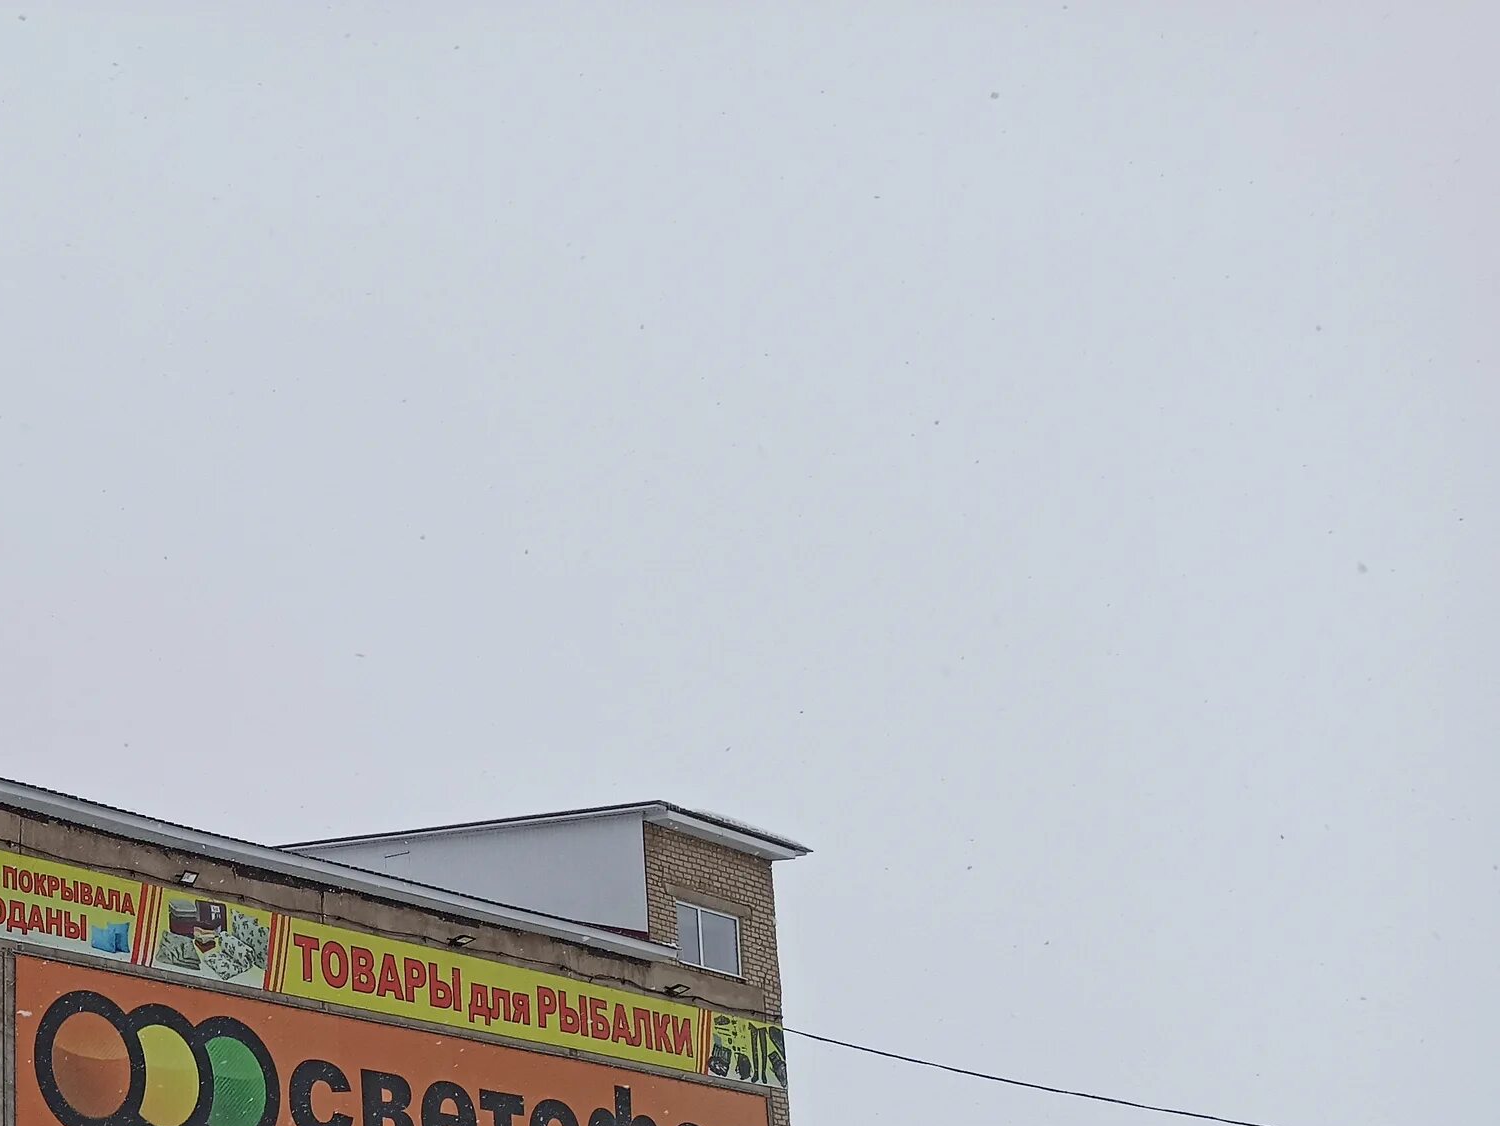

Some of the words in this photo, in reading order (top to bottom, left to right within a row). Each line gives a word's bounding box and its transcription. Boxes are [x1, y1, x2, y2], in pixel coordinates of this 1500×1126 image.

[2, 865, 136, 917] ПОКРЫВАЛА
[293, 933, 462, 1012] ТОВАРЫ
[468, 982, 530, 1026] для
[536, 985, 694, 1058] РЫБАЛКИ
